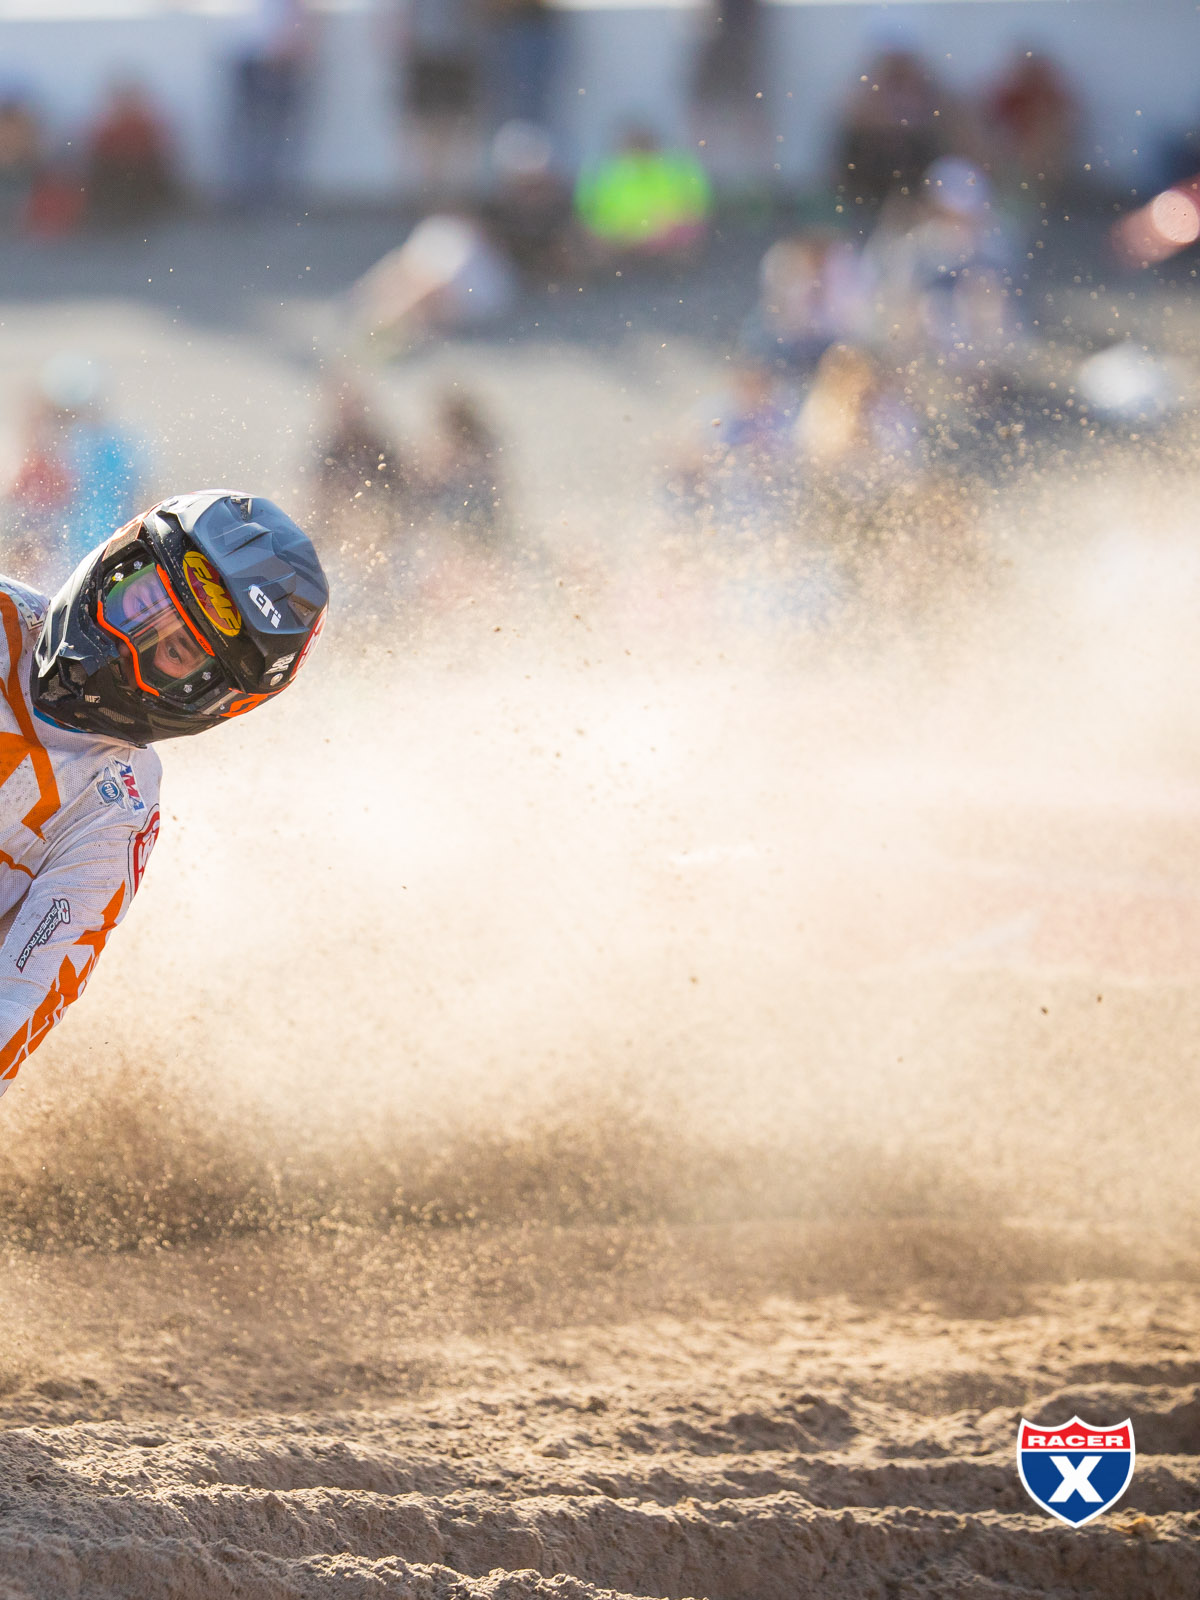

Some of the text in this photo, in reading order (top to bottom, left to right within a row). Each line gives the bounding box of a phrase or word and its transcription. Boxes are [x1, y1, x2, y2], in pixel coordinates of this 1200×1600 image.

[187, 556, 241, 634] FMF
[17, 907, 58, 967] SUPERTRUCKS
[39, 917, 59, 944] SOCAL
